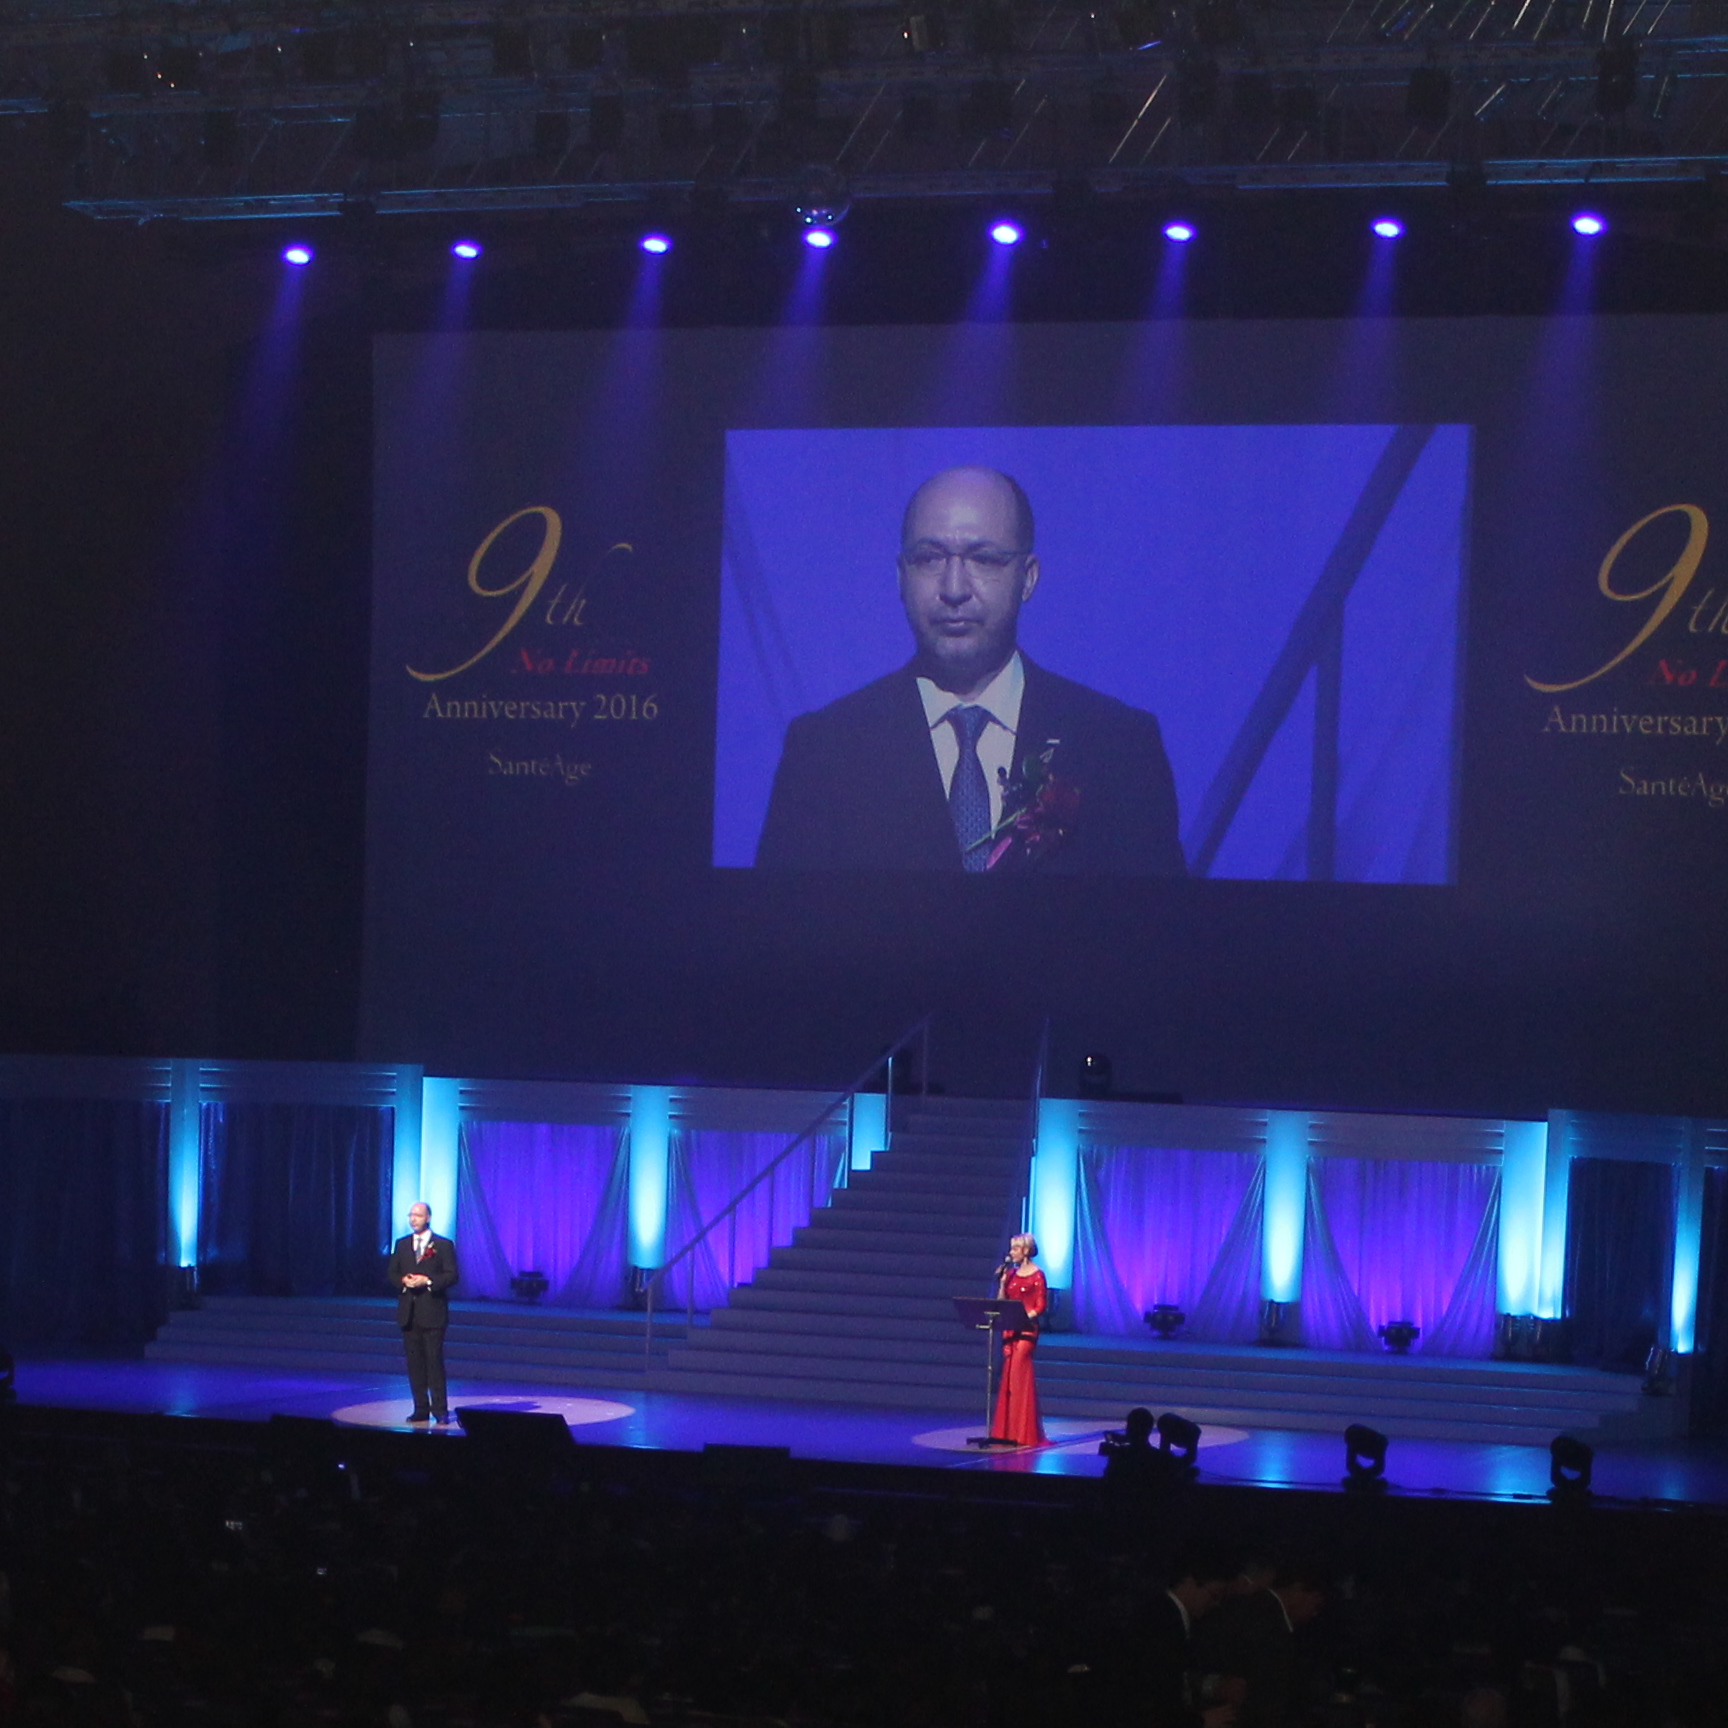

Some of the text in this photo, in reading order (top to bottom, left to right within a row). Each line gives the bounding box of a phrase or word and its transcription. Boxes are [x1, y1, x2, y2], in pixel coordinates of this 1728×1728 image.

[406, 506, 633, 681] 9th
[511, 649, 650, 675] No Limits
[1646, 659, 1697, 686] No
[423, 692, 659, 728] Anniversary 2016
